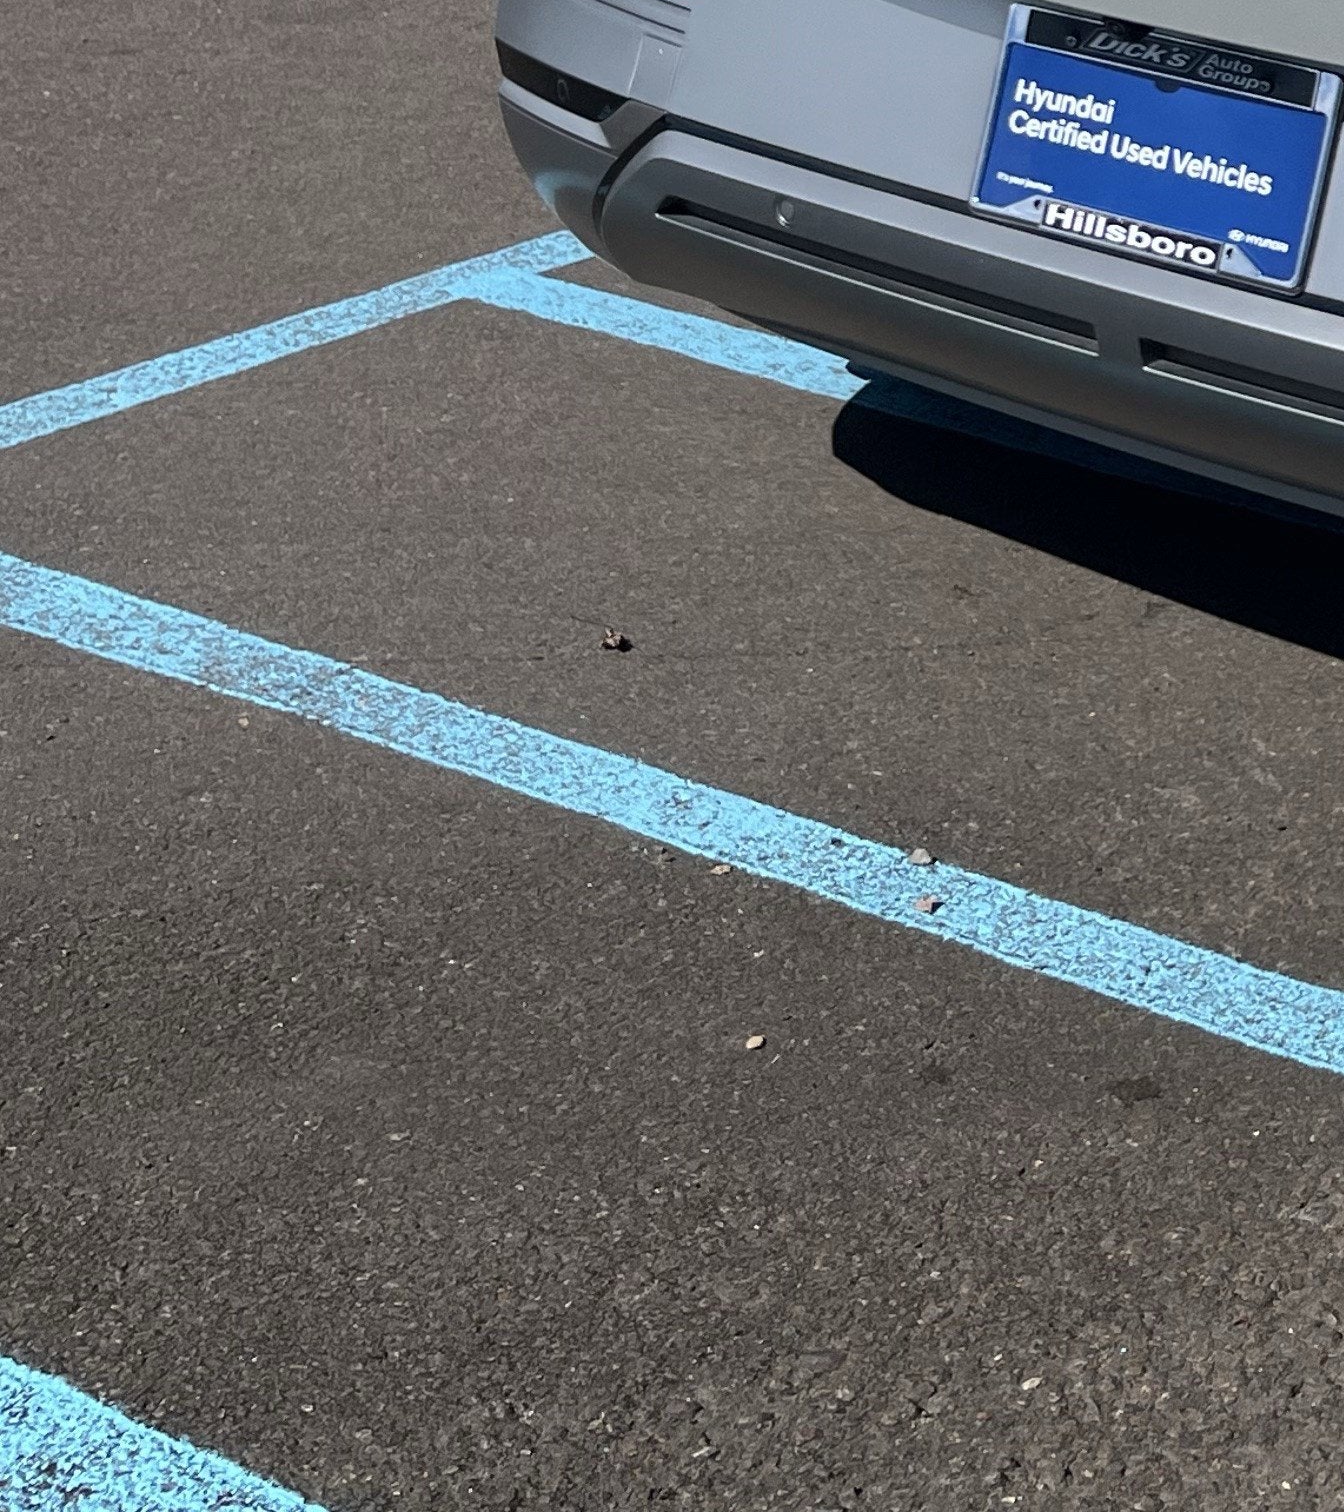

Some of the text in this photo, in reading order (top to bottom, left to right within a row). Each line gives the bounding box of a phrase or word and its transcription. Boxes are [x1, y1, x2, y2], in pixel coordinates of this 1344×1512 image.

[1204, 53, 1254, 75] Auto
[1014, 79, 1116, 125] Hyundai
[1008, 110, 1273, 196] Certified Used Vehicles
[1045, 202, 1216, 266] Hillsboro
